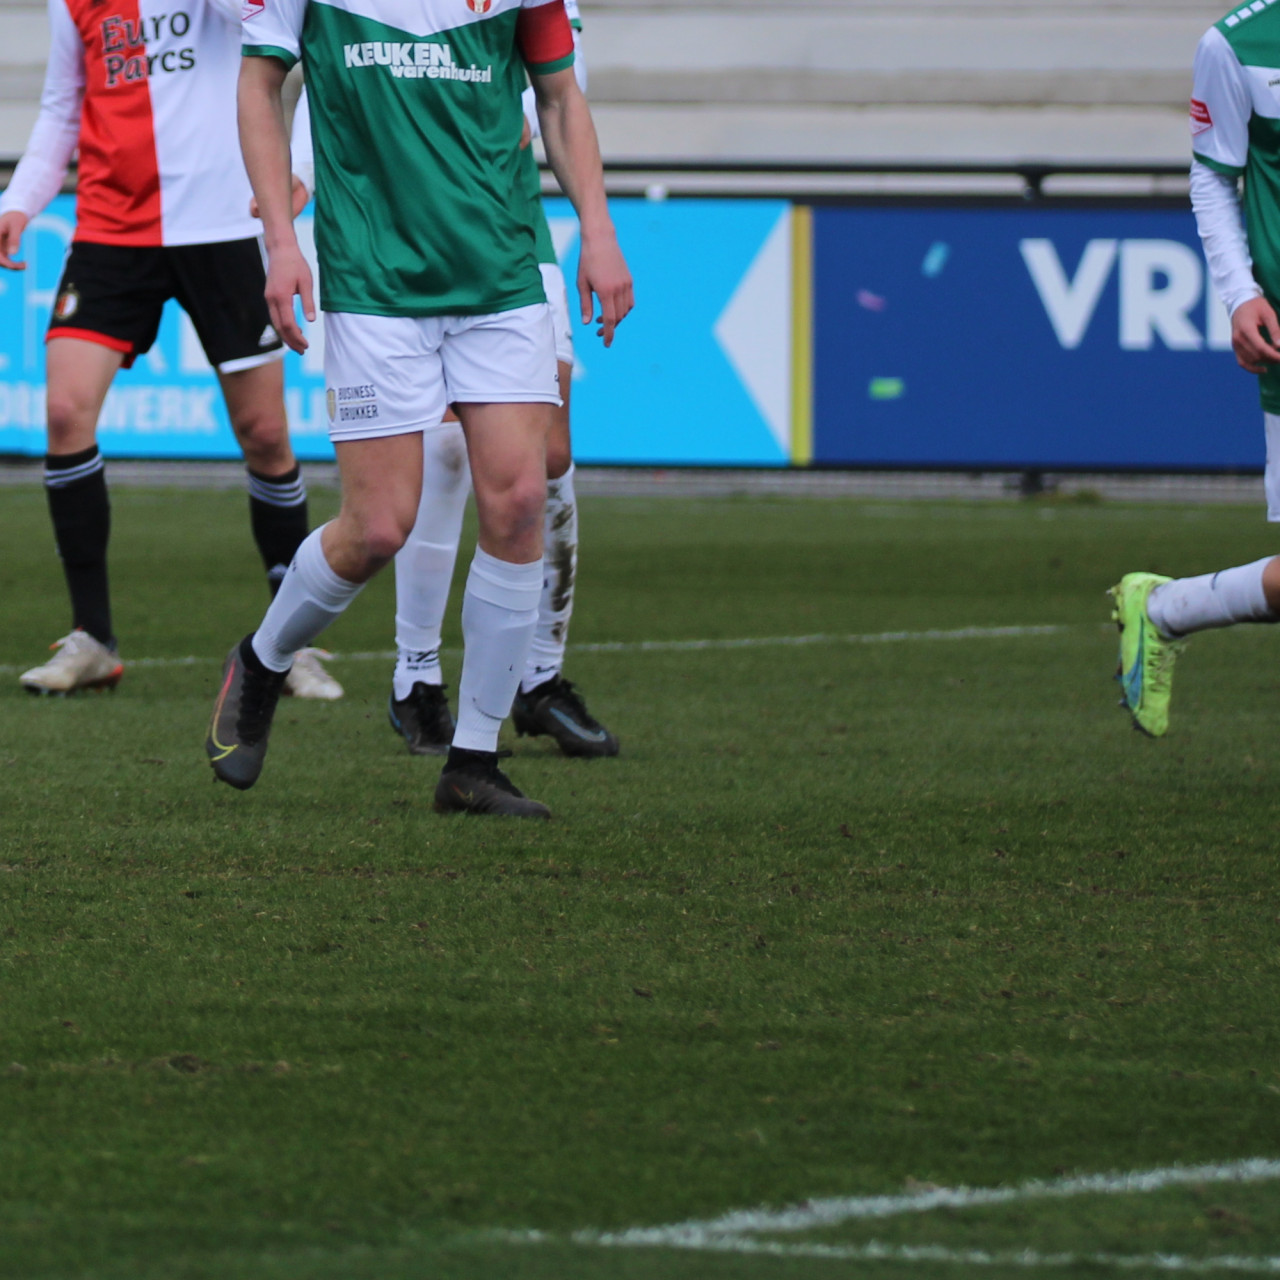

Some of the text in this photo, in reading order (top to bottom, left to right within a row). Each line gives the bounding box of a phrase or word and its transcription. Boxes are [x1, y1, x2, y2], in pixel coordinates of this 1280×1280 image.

[100, 11, 192, 55] Euro
[104, 47, 197, 89] Parcs
[343, 41, 451, 68] KEUKEN
[338, 384, 377, 401] BUSINESS
[339, 404, 380, 422] DRUKKER
